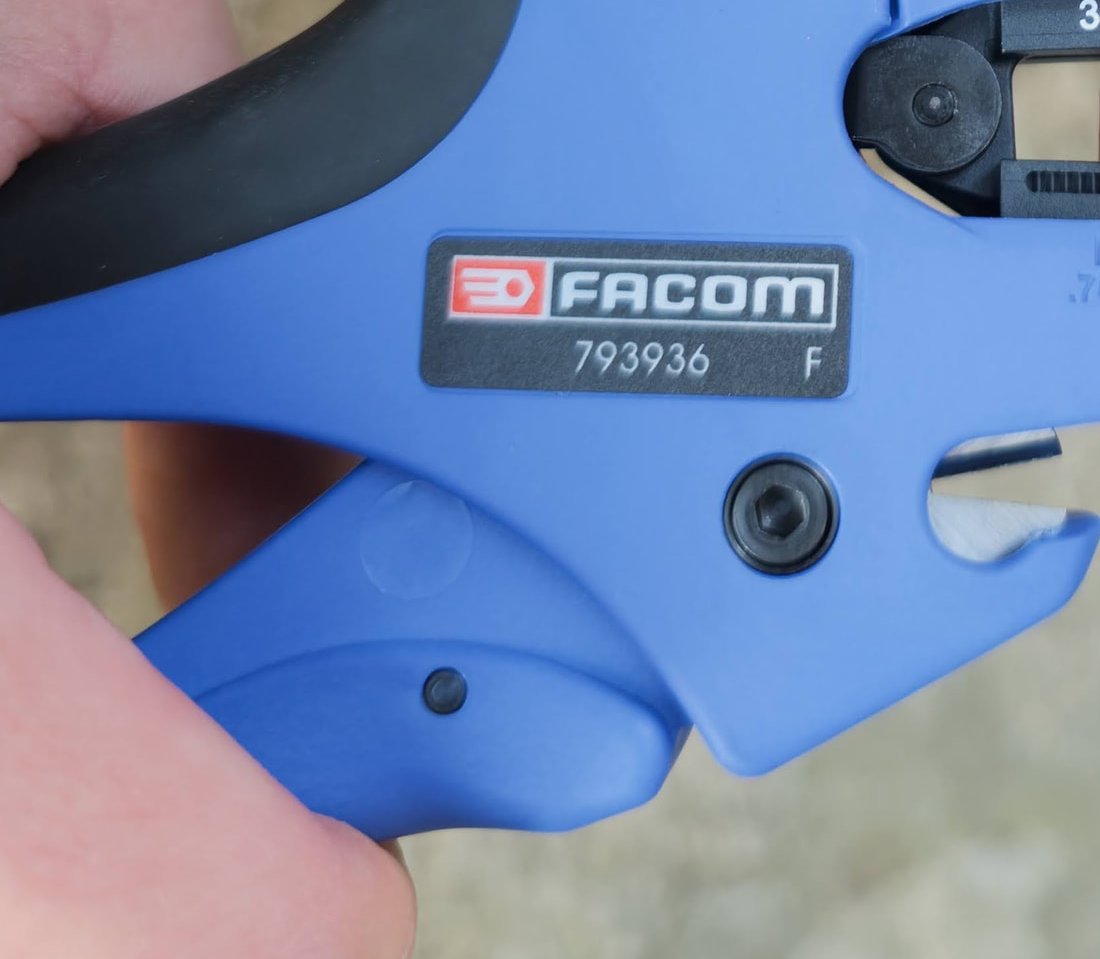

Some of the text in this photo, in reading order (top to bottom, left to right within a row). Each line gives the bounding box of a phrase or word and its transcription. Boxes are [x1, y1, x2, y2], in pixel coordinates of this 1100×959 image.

[559, 270, 825, 315] FACOM
[574, 340, 823, 381] 793936 F
